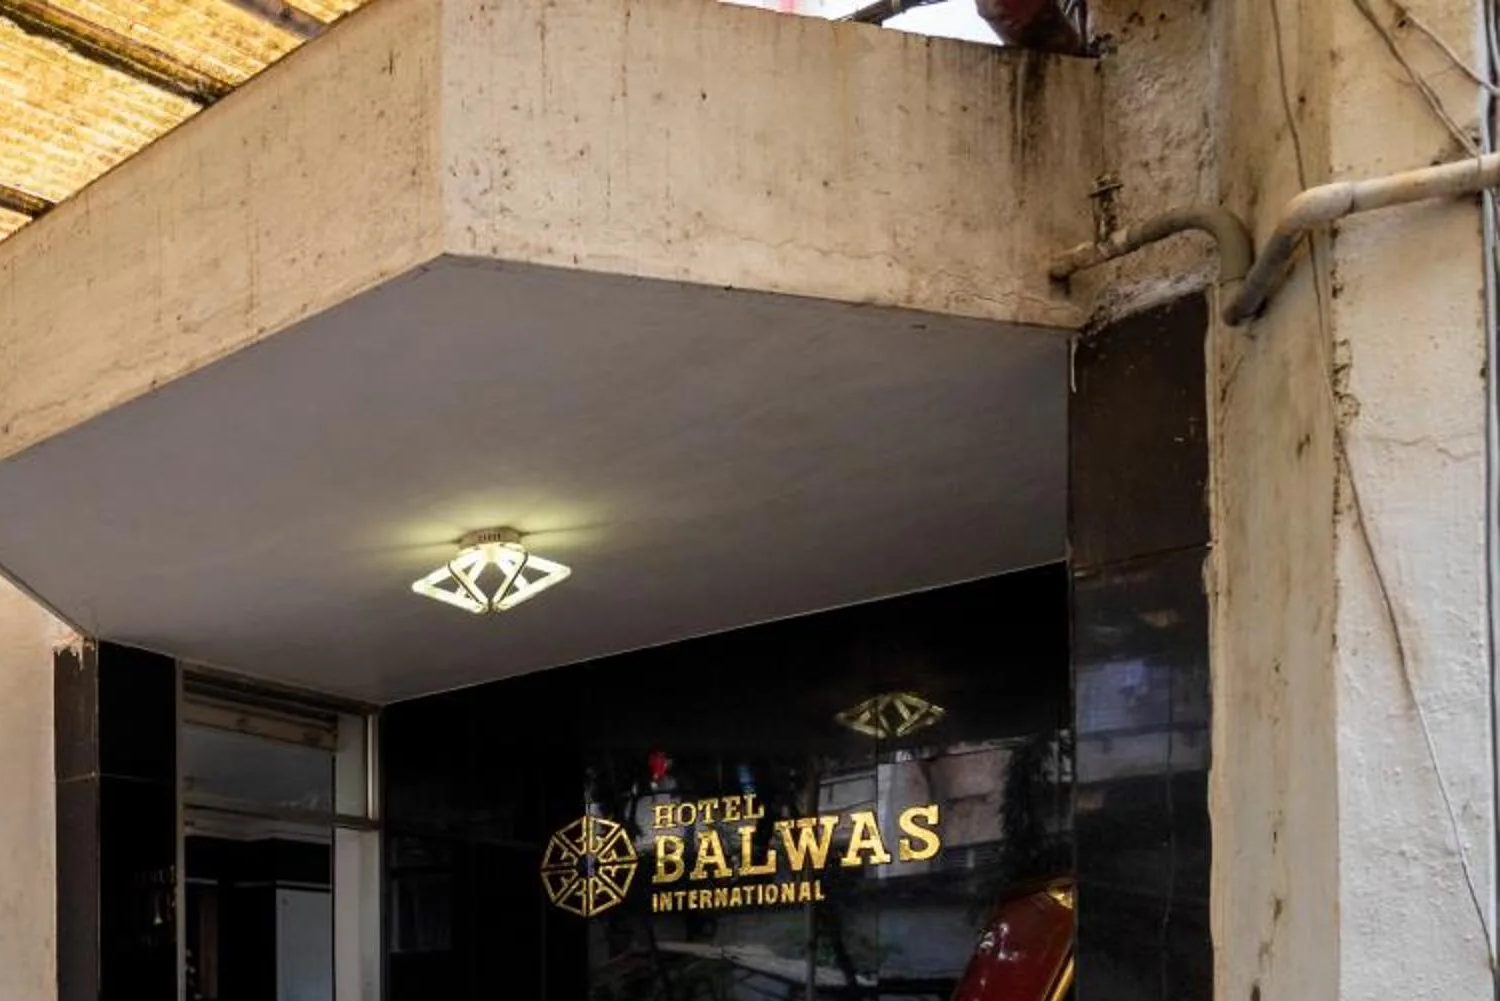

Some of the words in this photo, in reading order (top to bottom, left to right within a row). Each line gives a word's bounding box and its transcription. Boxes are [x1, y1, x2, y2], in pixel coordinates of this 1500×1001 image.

[652, 793, 765, 829] HOTEL
[652, 805, 941, 884] BALWAS
[652, 880, 825, 913] INTERNATIONAL
